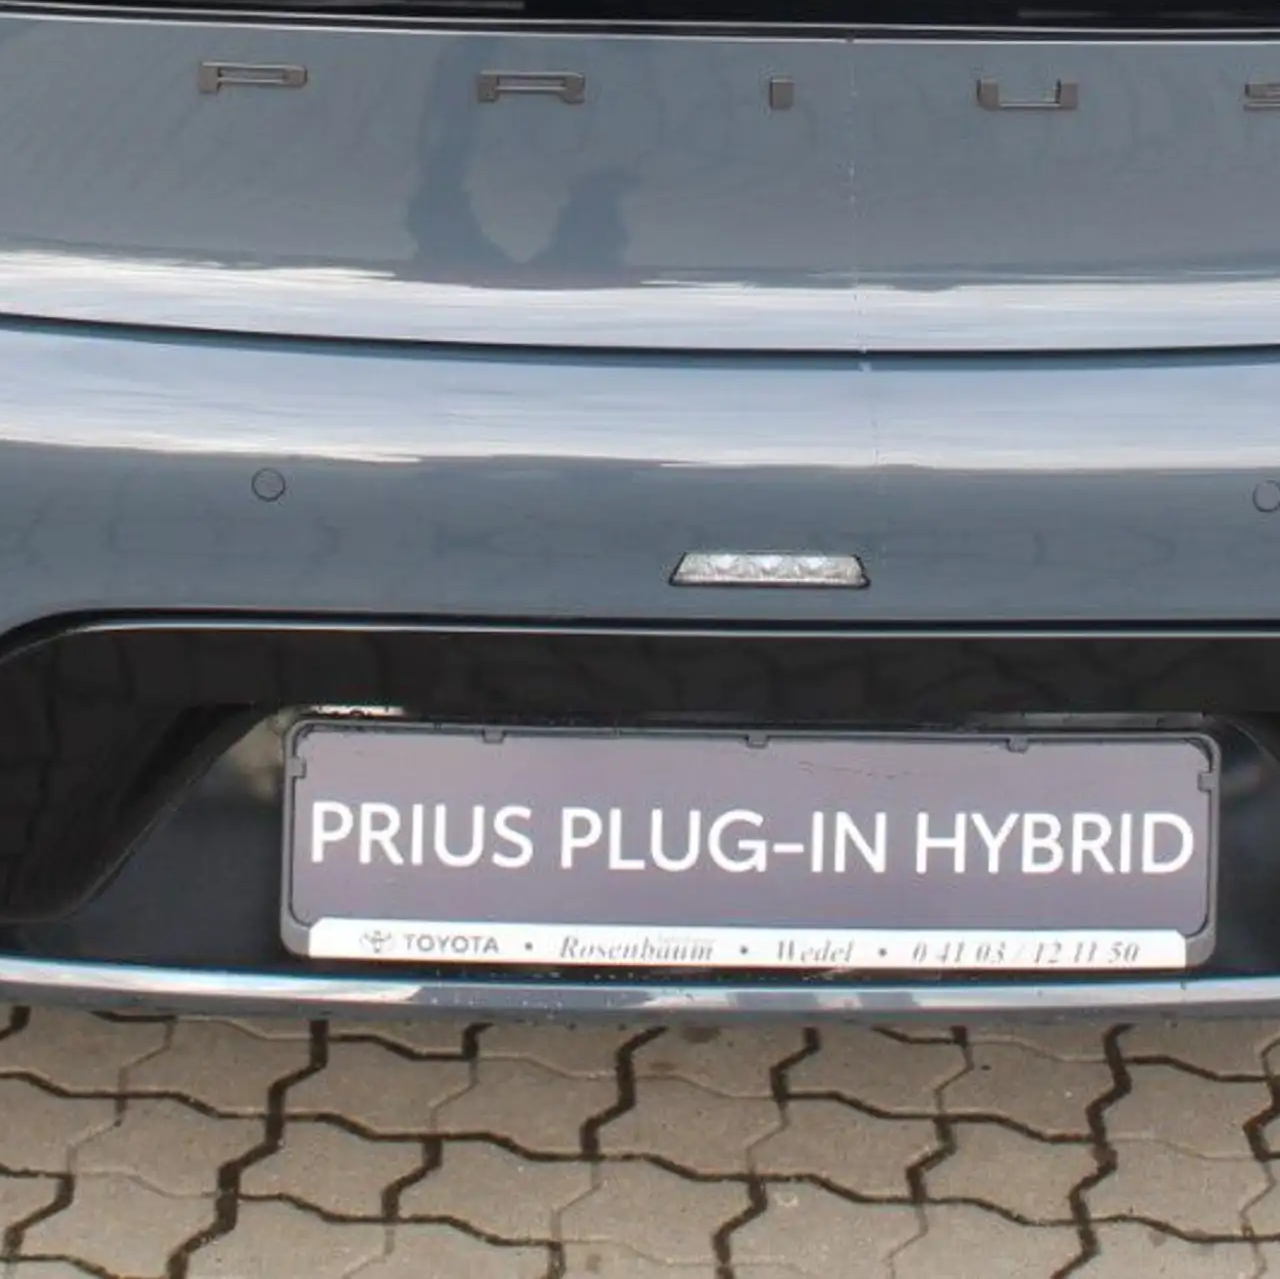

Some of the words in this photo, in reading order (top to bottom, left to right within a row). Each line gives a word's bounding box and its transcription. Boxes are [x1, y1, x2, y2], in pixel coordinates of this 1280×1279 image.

[311, 801, 533, 869] PRIUS
[560, 807, 887, 873] PLUG-IN
[916, 812, 1194, 875] HYBRID
[403, 933, 500, 955] TOYOTA
[559, 934, 715, 962] Rosenbaum
[776, 939, 854, 963] Wedel
